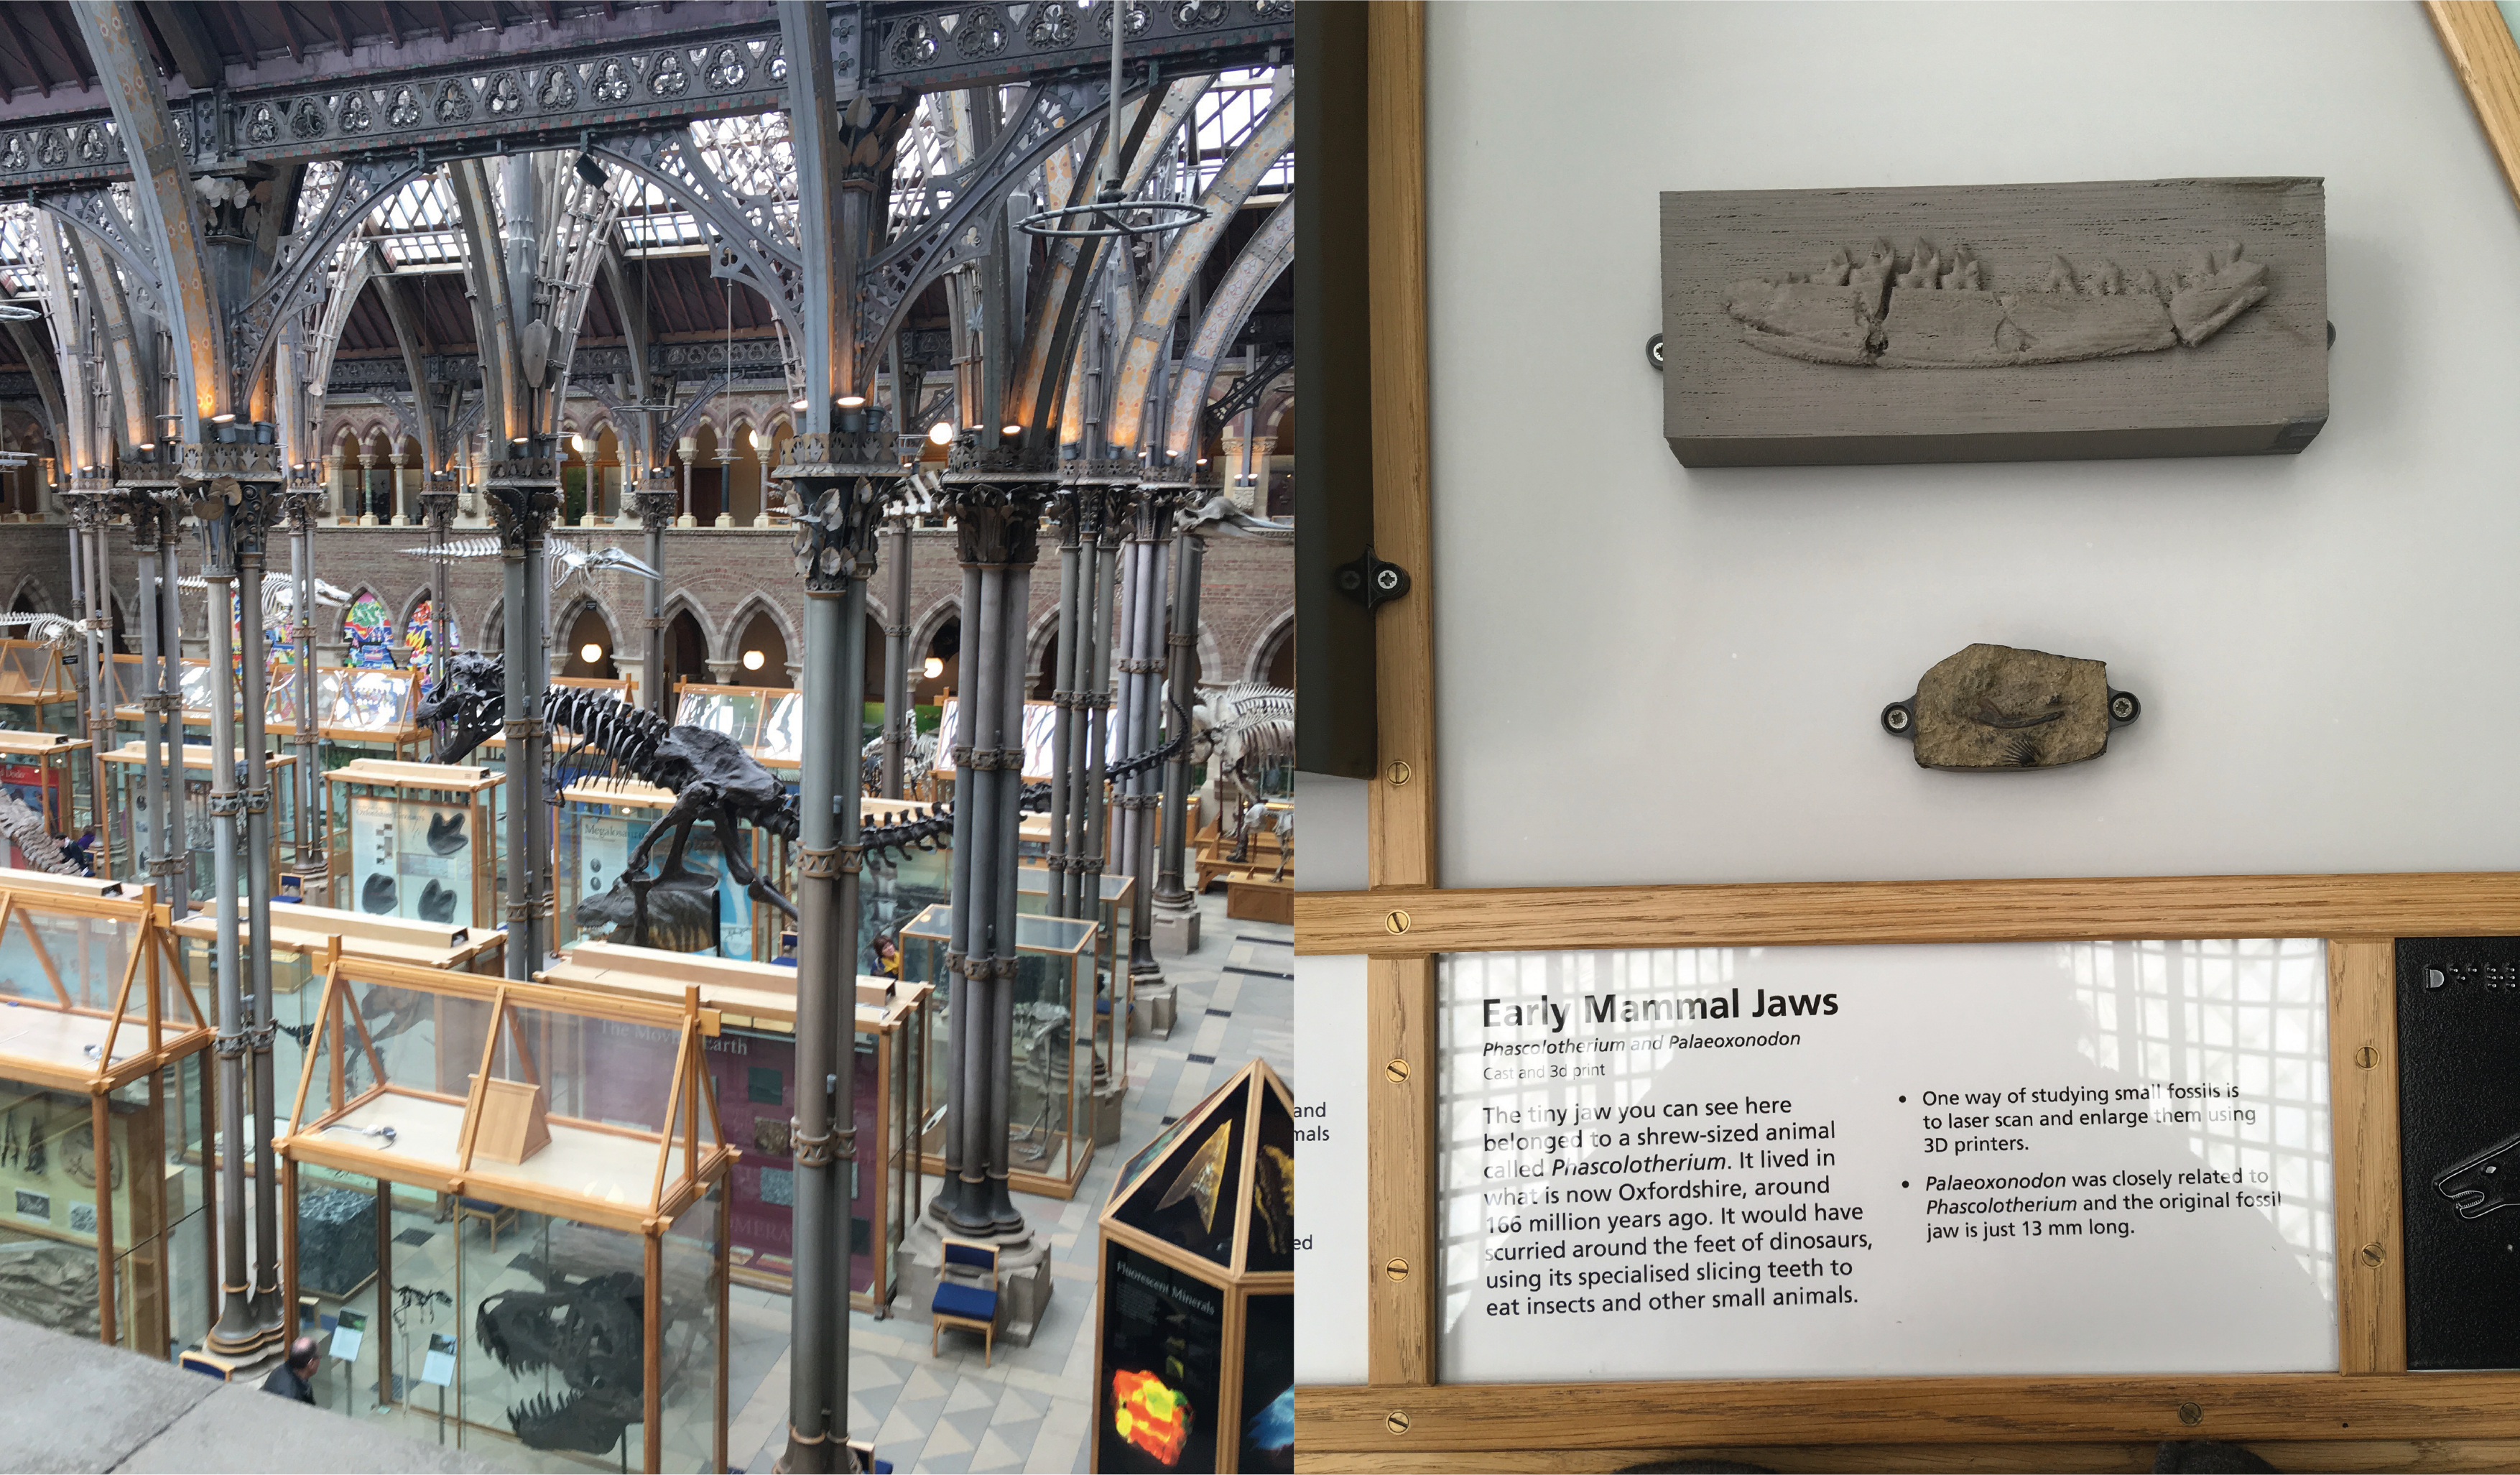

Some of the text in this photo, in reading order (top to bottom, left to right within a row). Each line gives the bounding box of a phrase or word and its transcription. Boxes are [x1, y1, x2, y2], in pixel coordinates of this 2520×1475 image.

[585, 824, 645, 839] Megalosauru
[1483, 987, 1839, 1033] Early Mammal Jaws
[598, 1019, 630, 1037] The
[705, 1037, 748, 1056] Earth
[1483, 1030, 1801, 1057] Phascolotherium and Palaeoxonodon
[1483, 1063, 1606, 1081] Cast and 3d print
[1922, 1082, 2239, 1109] One way of studying small fossils is
[1482, 1096, 1792, 1127] The tiny jaw you can see here
[1922, 1106, 2256, 1129] to laser scan and enlarge them using
[1484, 1120, 1835, 1155] belonged to a shrew-sized animal
[1924, 1135, 2029, 1157] 3D printers.
[1483, 1148, 1835, 1179] called Phascolotherium. It lived in
[1483, 1175, 1830, 1206] what is now Oxfordshire, around
[1925, 1167, 2269, 1191] Palaeoxonodon was closely related to
[1926, 1190, 2282, 1215] Phascolotherium and the original fossil
[1486, 1202, 1863, 1234] 166 million years ago. It would have
[1926, 1218, 2135, 1243] jaw is just 13 mm long.
[1485, 1231, 1872, 1261] scurried around the feet of dinosaurs,
[1117, 1260, 1170, 1295] Fluorescent
[1172, 1286, 1215, 1316] Minerals
[1486, 1257, 1853, 1293] using its specialised slicing teeth to
[1486, 1285, 1858, 1316] eat insects and other small animals.
